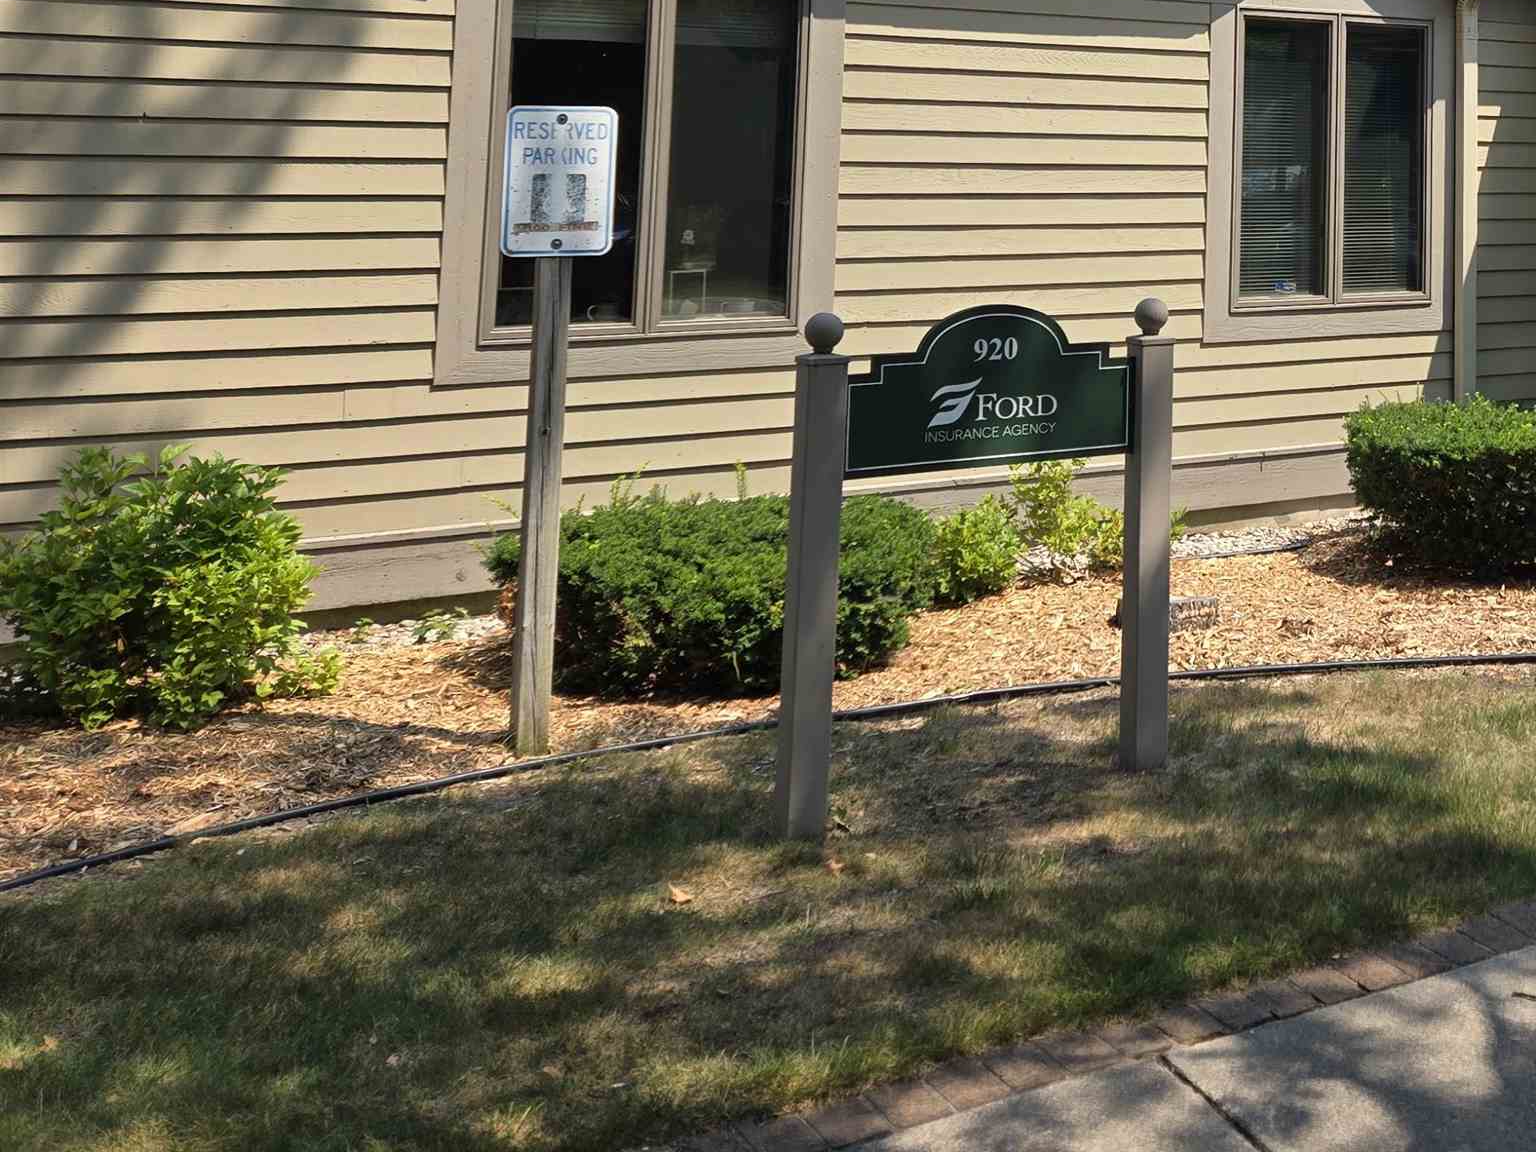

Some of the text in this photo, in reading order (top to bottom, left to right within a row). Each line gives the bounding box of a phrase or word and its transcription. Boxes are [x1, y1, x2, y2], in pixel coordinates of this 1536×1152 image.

[514, 121, 608, 141] RESERVED
[522, 147, 598, 166] PARKING
[974, 336, 1018, 362] 920
[975, 392, 1058, 421] FORD
[924, 422, 1057, 443] INSURANCE AGENCY
